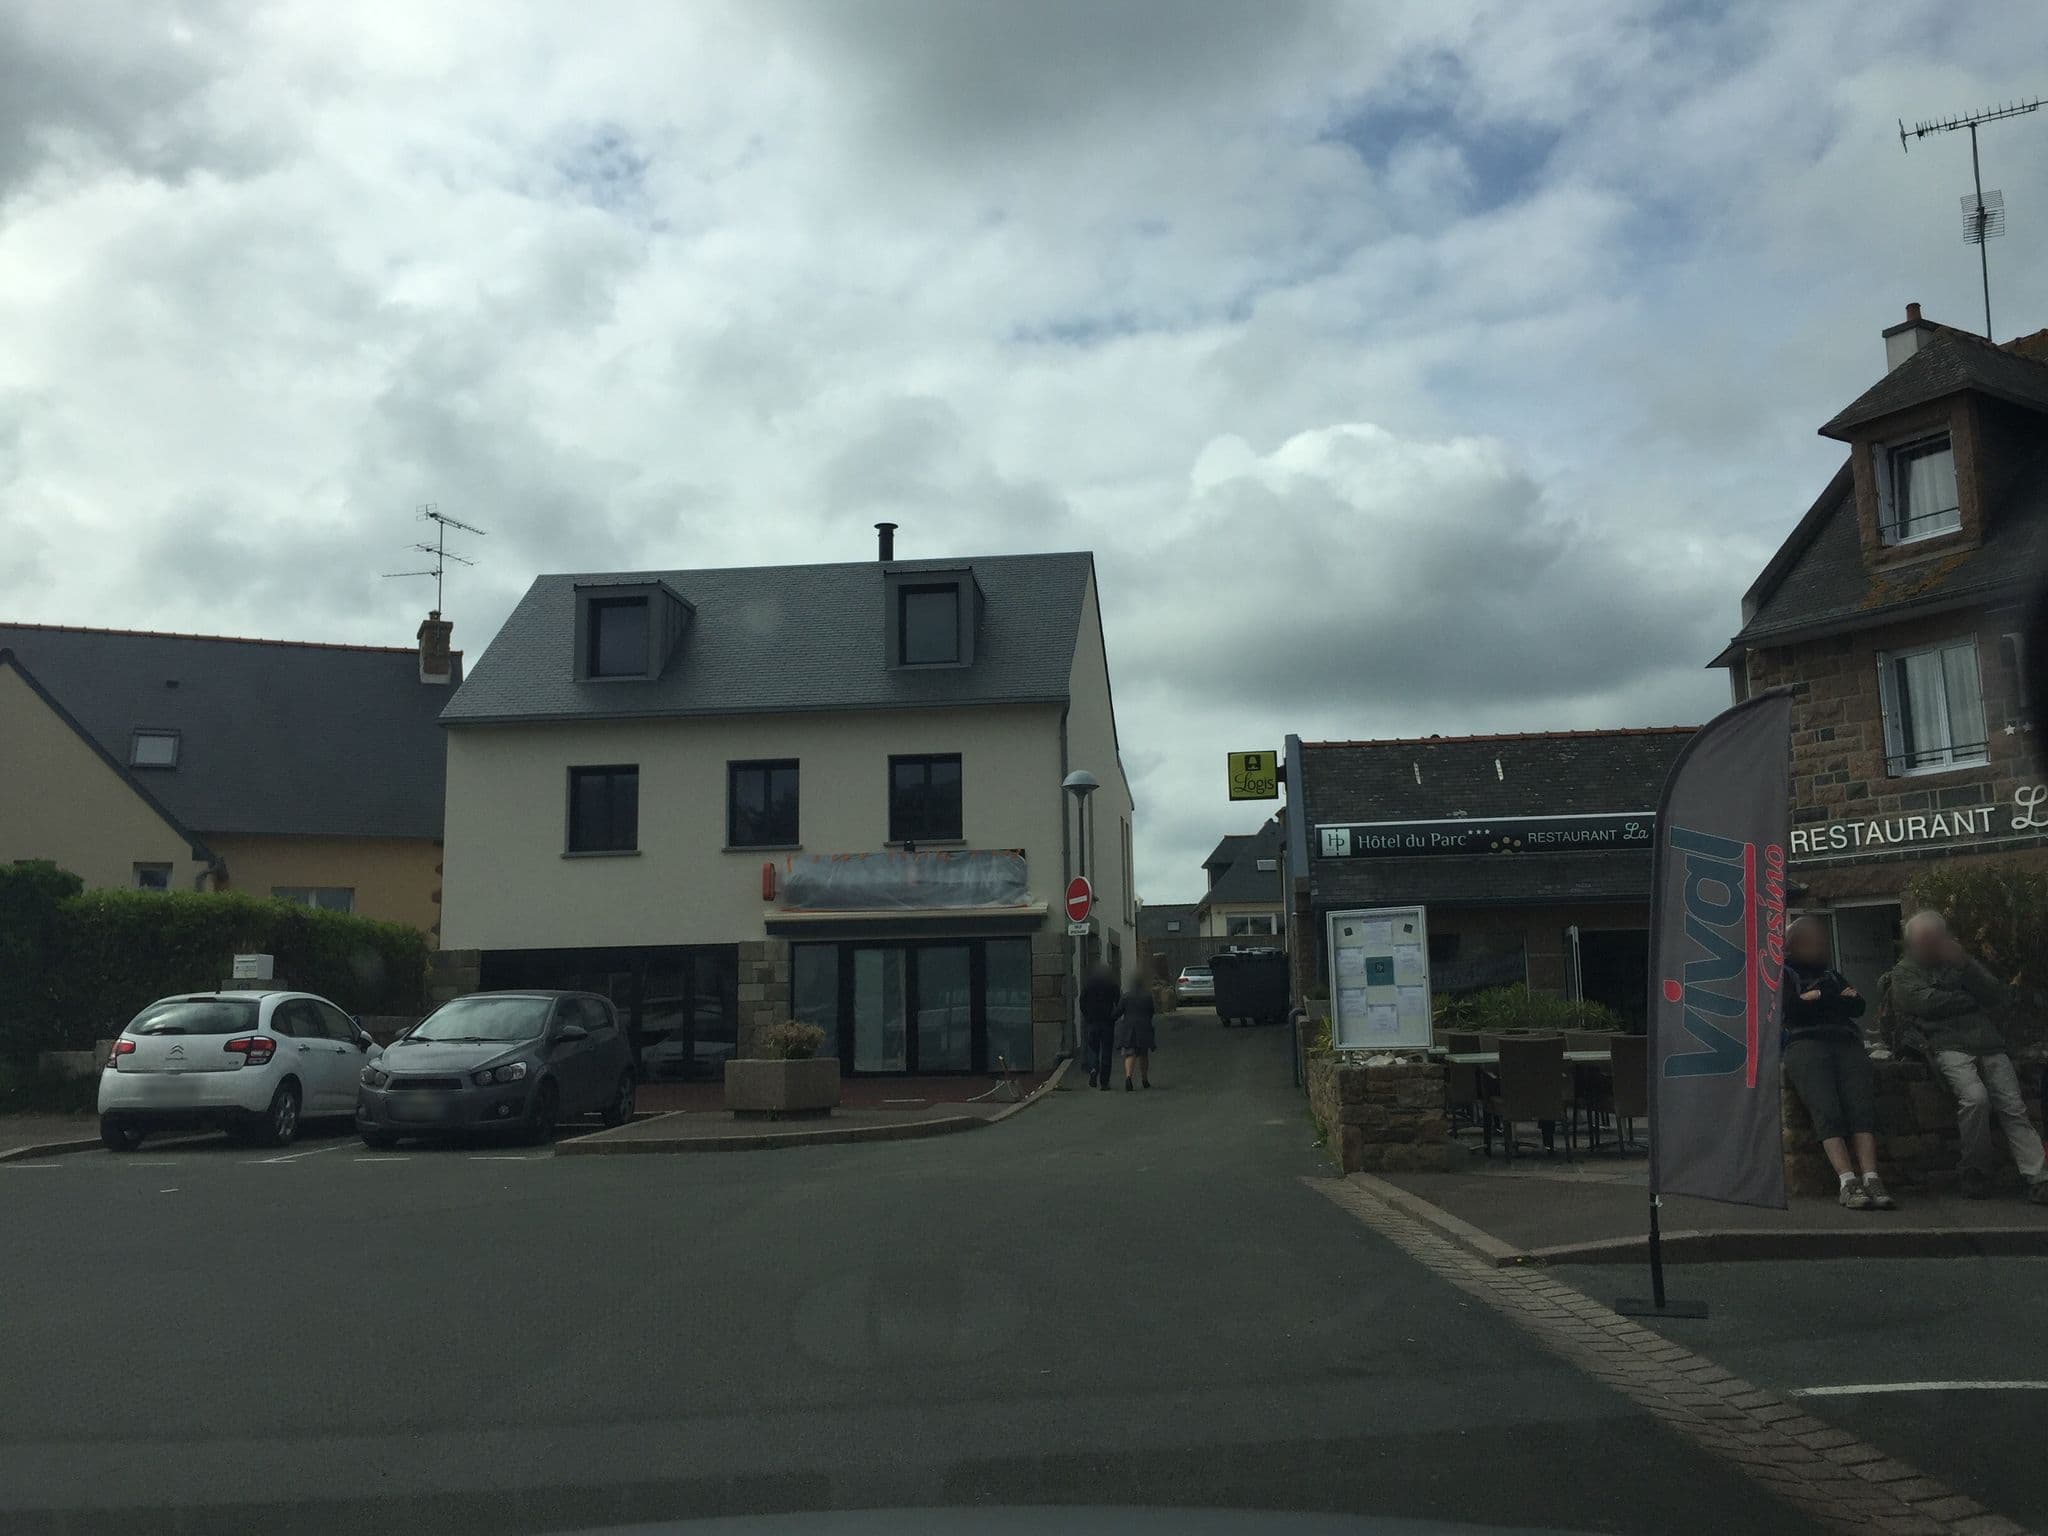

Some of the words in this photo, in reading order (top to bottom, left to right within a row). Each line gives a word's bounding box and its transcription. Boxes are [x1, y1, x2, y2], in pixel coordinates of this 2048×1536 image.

[1233, 771, 1275, 795] Logis
[1358, 834, 1401, 849] Hôtel
[1405, 834, 1425, 848] du
[1431, 832, 1467, 847] Parc
[1527, 829, 1618, 844] RESTAURANT
[1622, 822, 1649, 840] La
[1789, 807, 1996, 854] RESTAURANT
[1757, 844, 1785, 993] Casino
[1663, 825, 1748, 1078] vival
